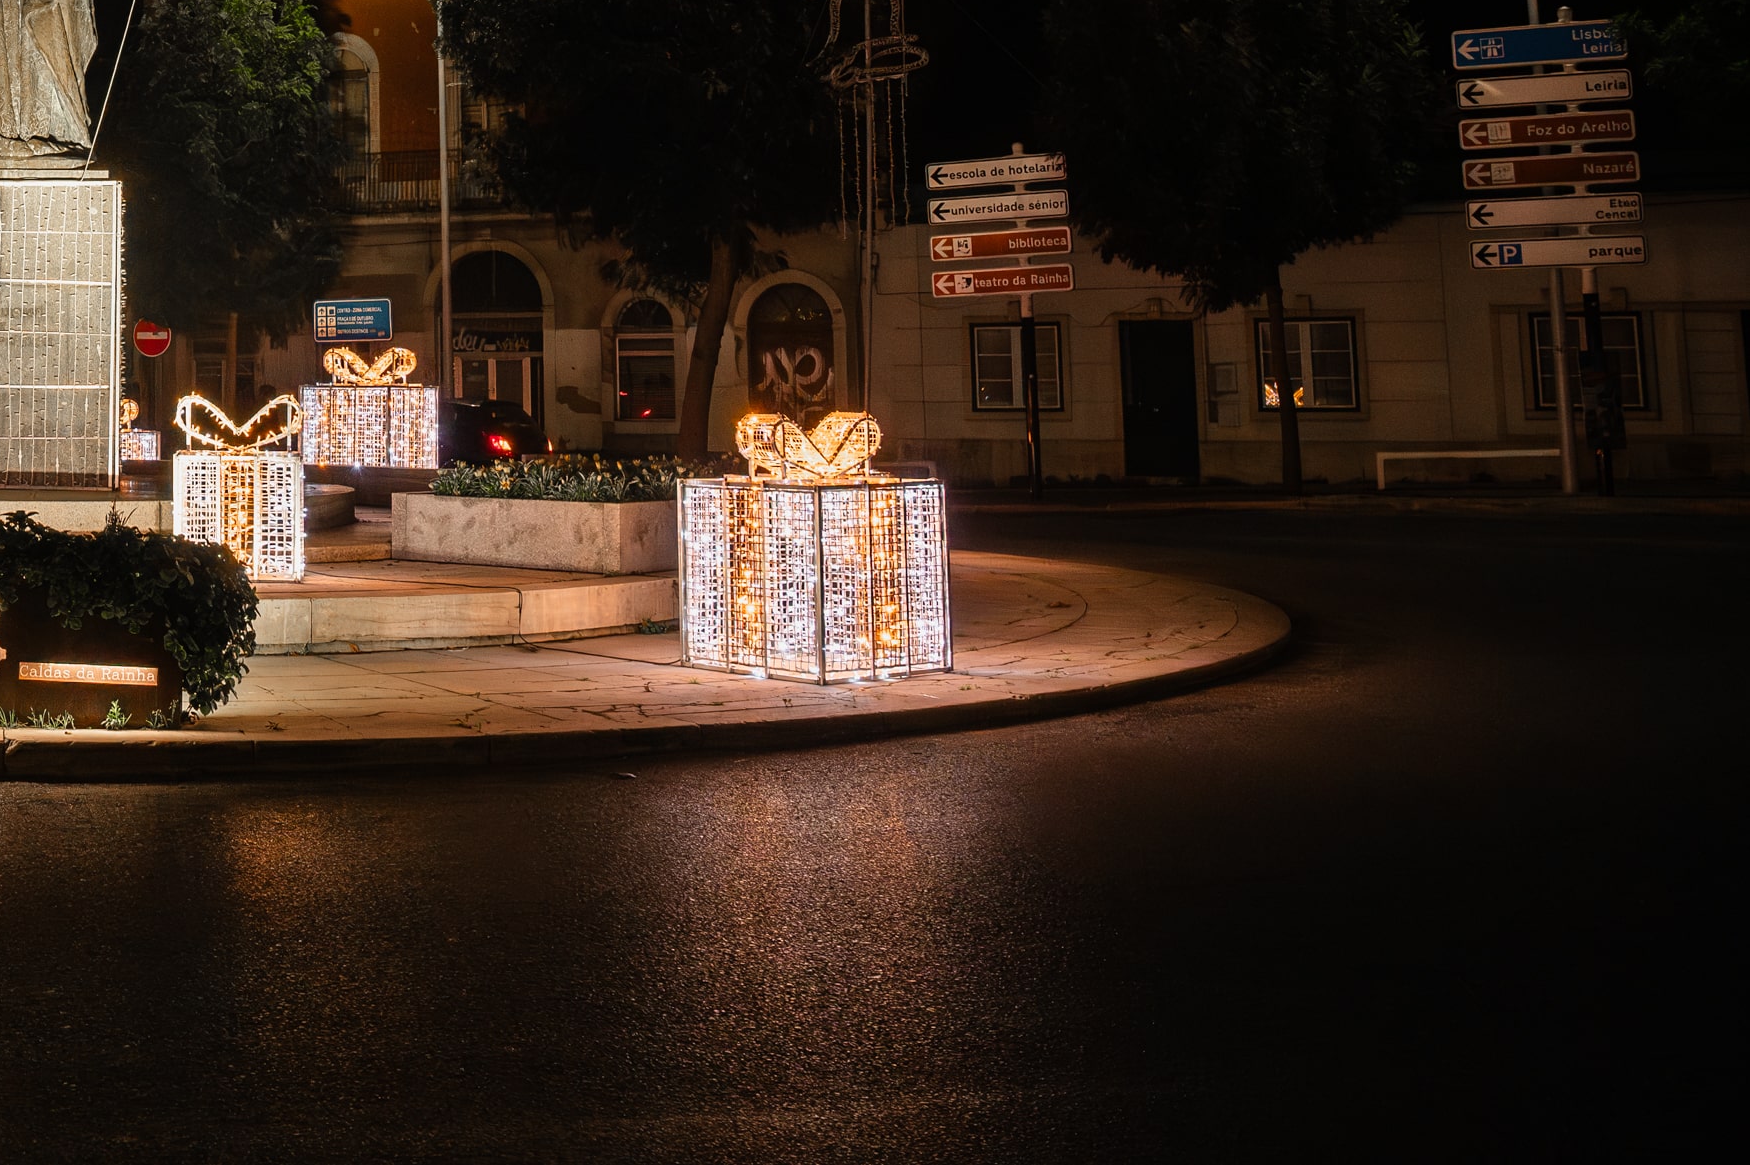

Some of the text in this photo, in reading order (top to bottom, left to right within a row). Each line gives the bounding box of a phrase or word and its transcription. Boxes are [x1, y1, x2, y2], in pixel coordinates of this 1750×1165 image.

[1585, 79, 1627, 93] Leiria
[1527, 120, 1630, 137] Foz do Arelho
[949, 168, 986, 180] escola
[990, 166, 1005, 177] de
[1583, 161, 1635, 175] Nazaré
[951, 199, 1065, 216] universidade sénior
[1595, 210, 1638, 221] Cencal
[1008, 236, 1067, 249] biblioteca
[1588, 245, 1643, 258] parque
[975, 273, 1070, 289] teatro da Rainha
[19, 664, 156, 683] Caldas da Rainha
